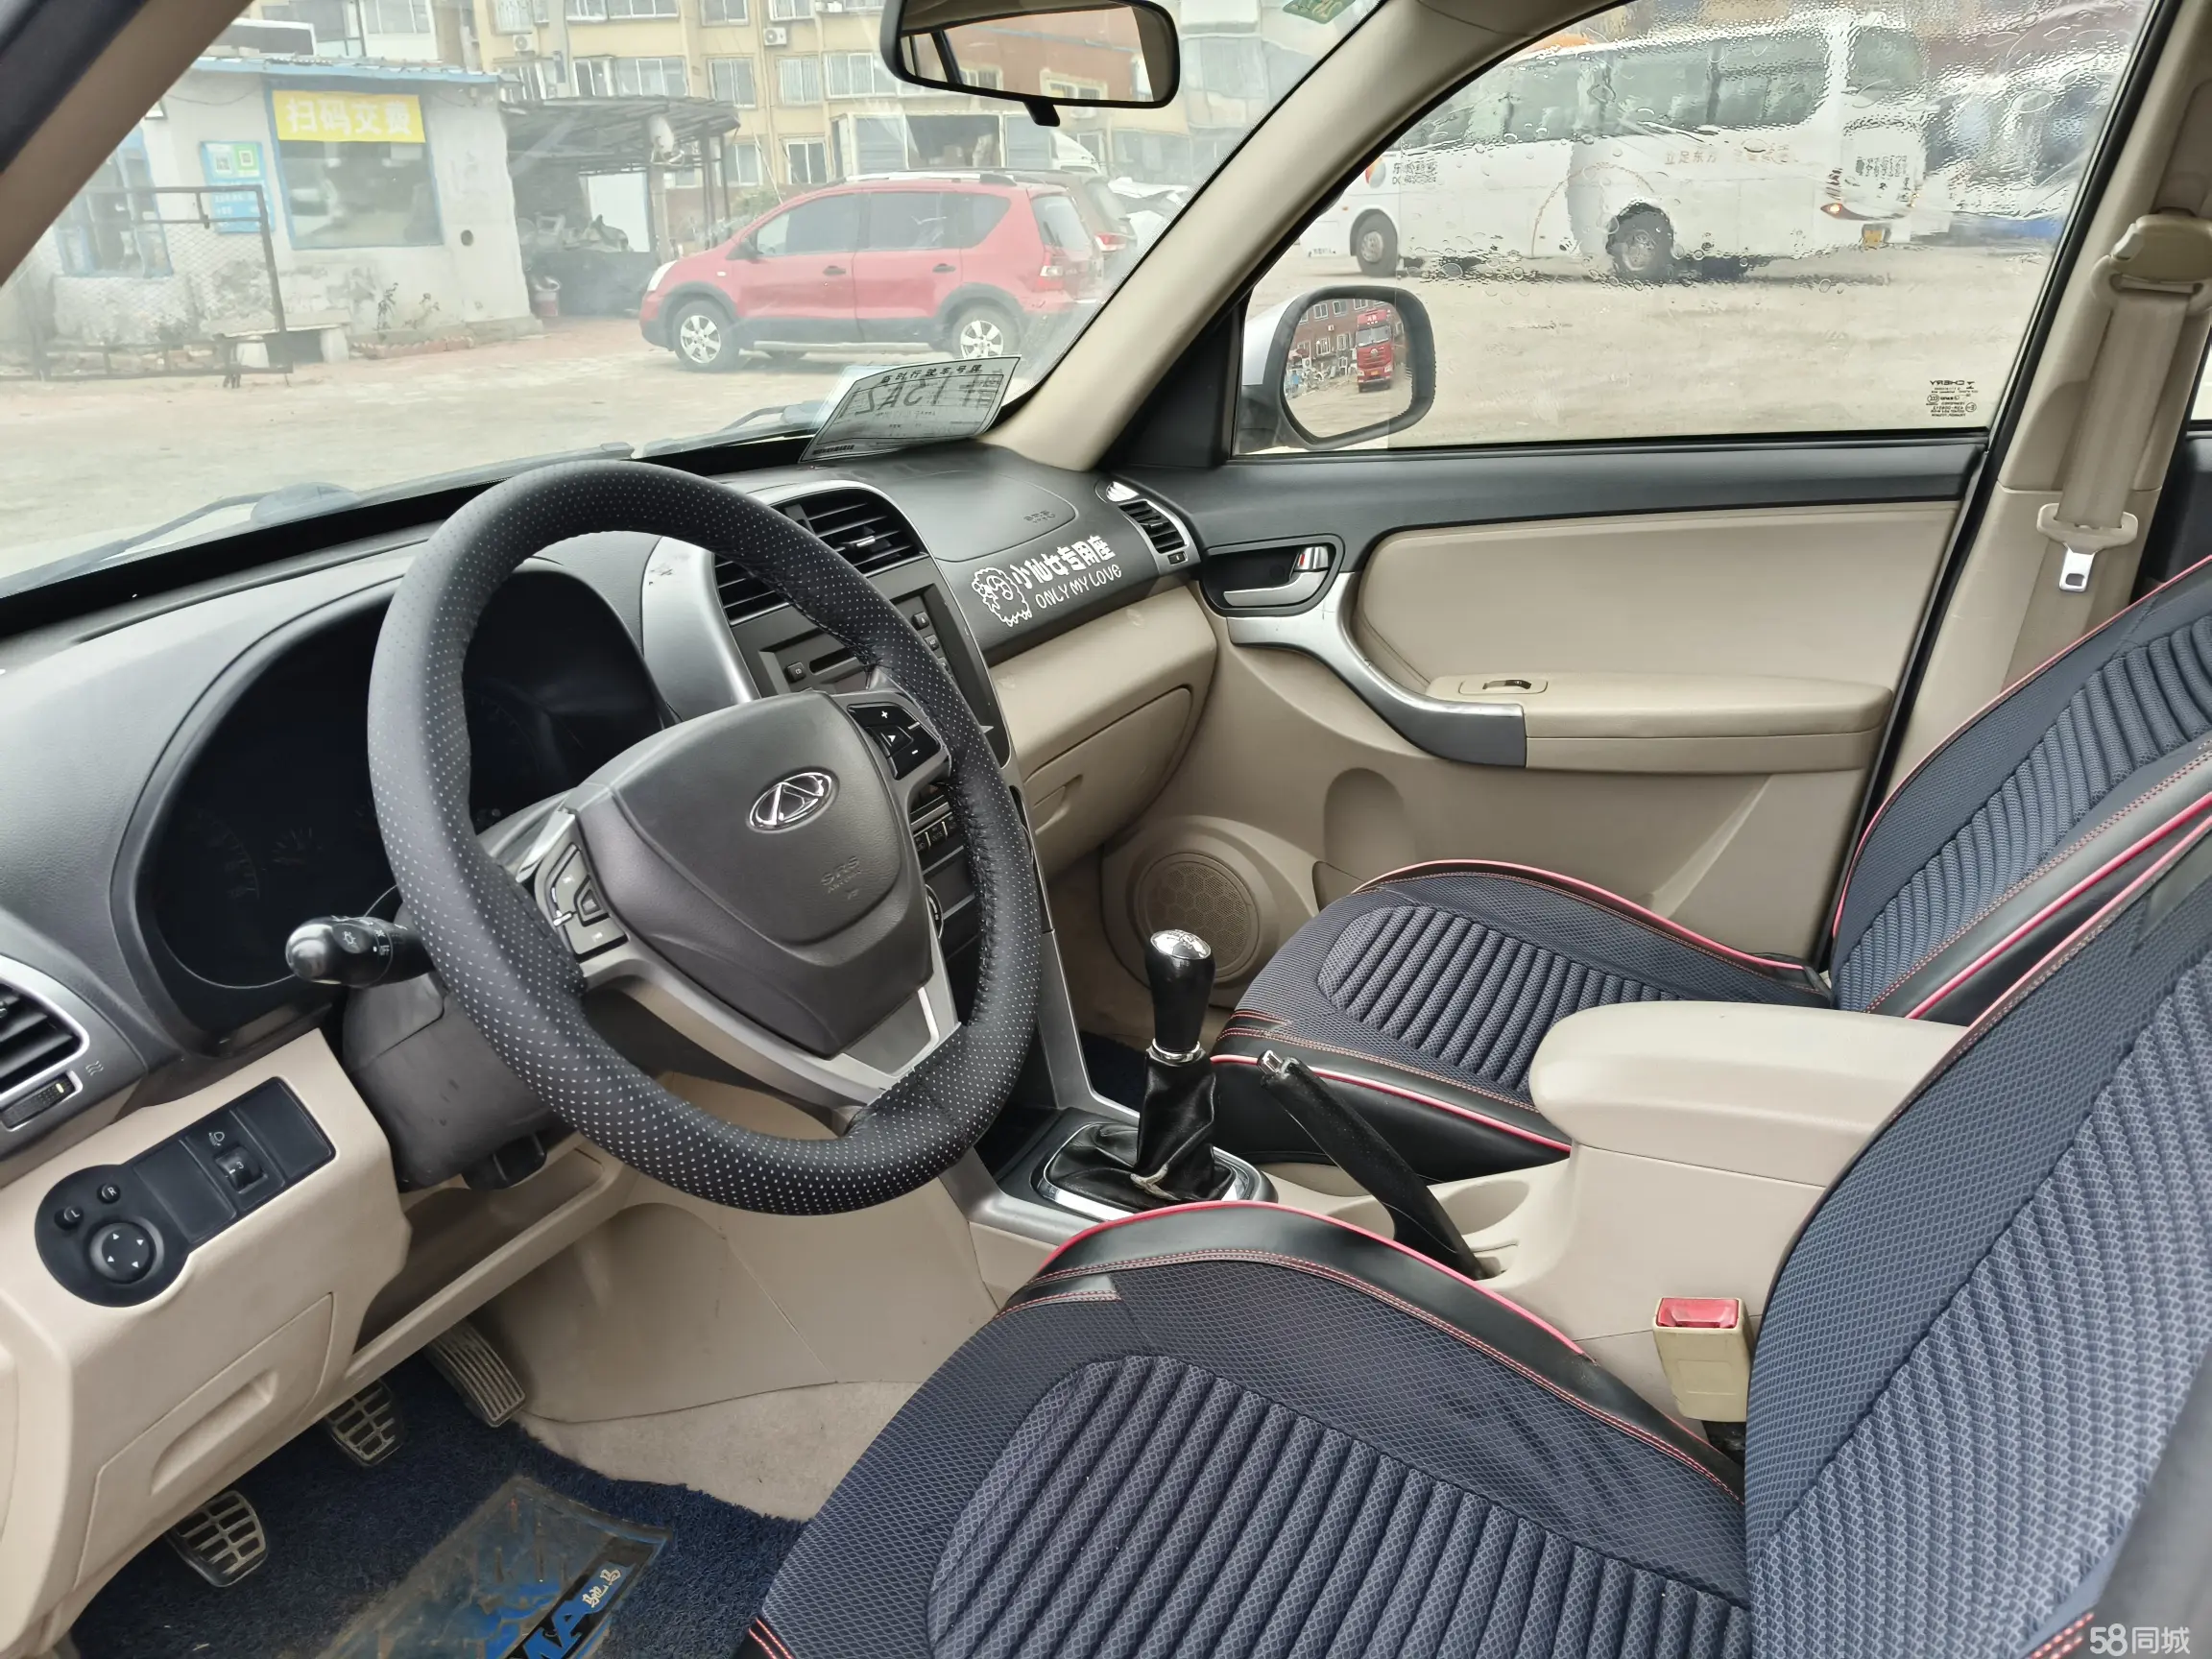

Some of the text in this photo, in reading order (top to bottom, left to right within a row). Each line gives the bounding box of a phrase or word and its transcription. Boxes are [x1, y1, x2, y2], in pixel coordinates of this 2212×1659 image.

[286, 98, 412, 135] 扫码交费
[1009, 535, 1116, 589] 小仙女专用座
[1035, 564, 1121, 609] ONLY MY LOVE
[107, 1187, 117, 1196] R
[70, 1209, 80, 1218] L
